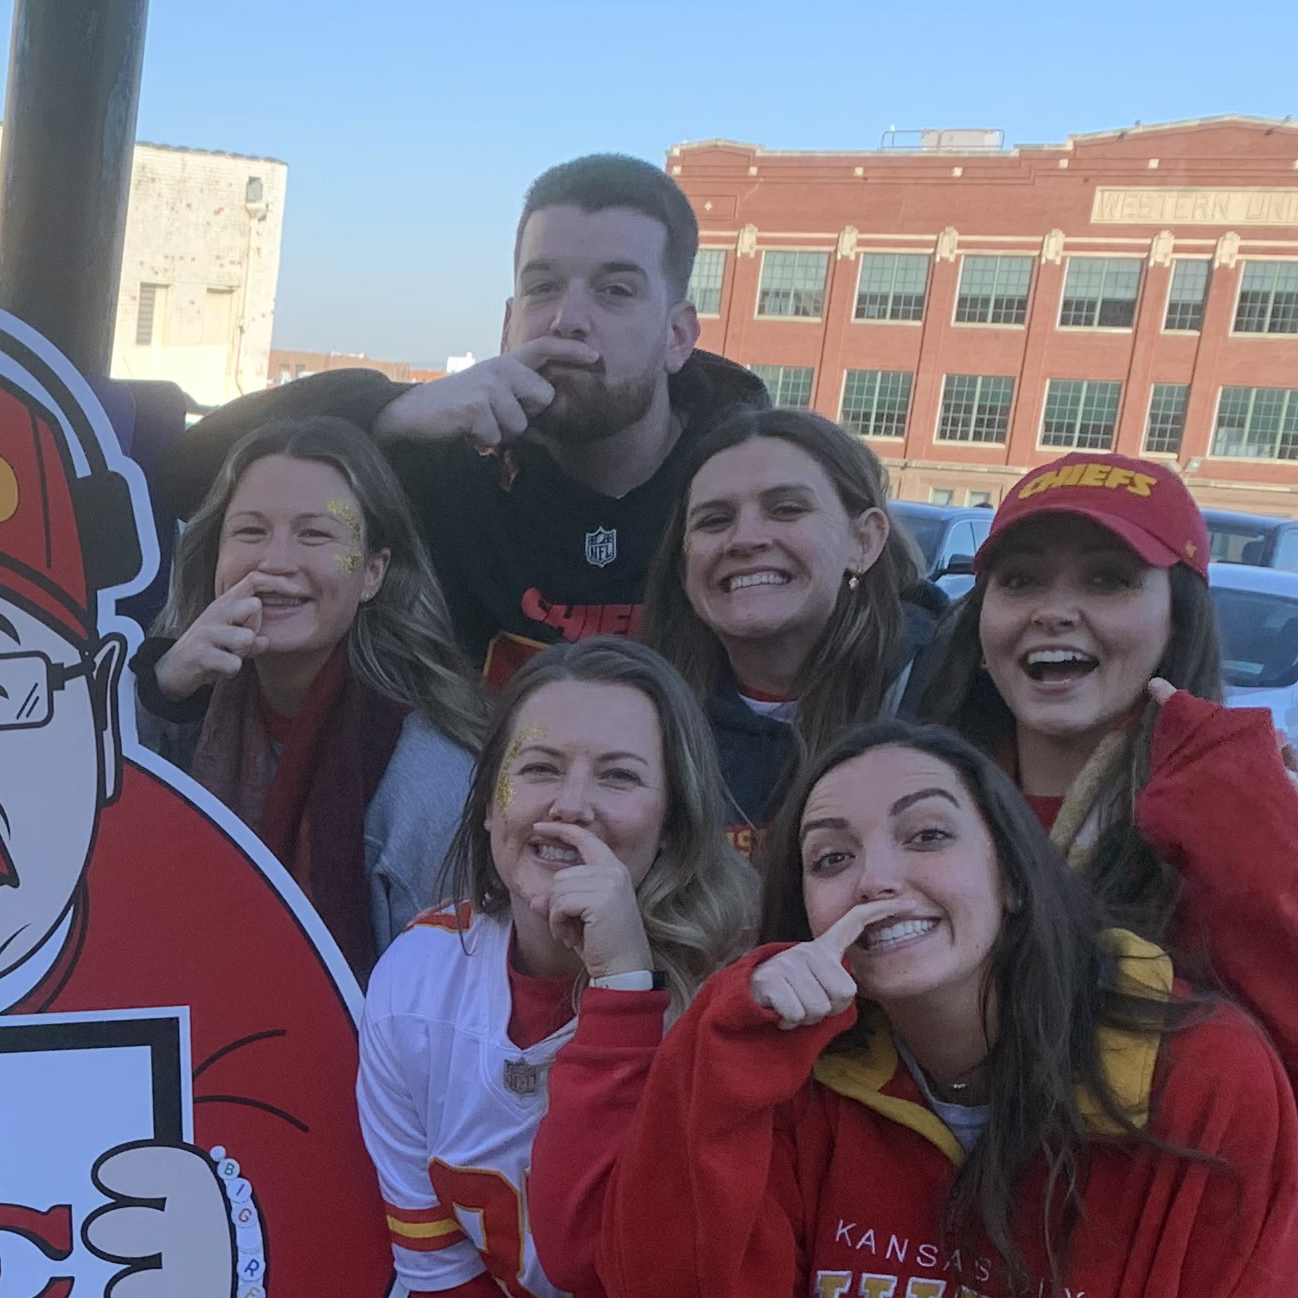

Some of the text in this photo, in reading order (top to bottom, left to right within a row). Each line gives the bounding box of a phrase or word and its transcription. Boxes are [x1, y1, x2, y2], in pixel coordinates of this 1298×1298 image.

[1102, 192, 1298, 219] WESTERN UNI
[1018, 464, 1157, 499] CHIEFS
[521, 586, 646, 644] CHIE
[222, 1161, 253, 1224] BIG
[835, 1219, 992, 1282] KANSAS
